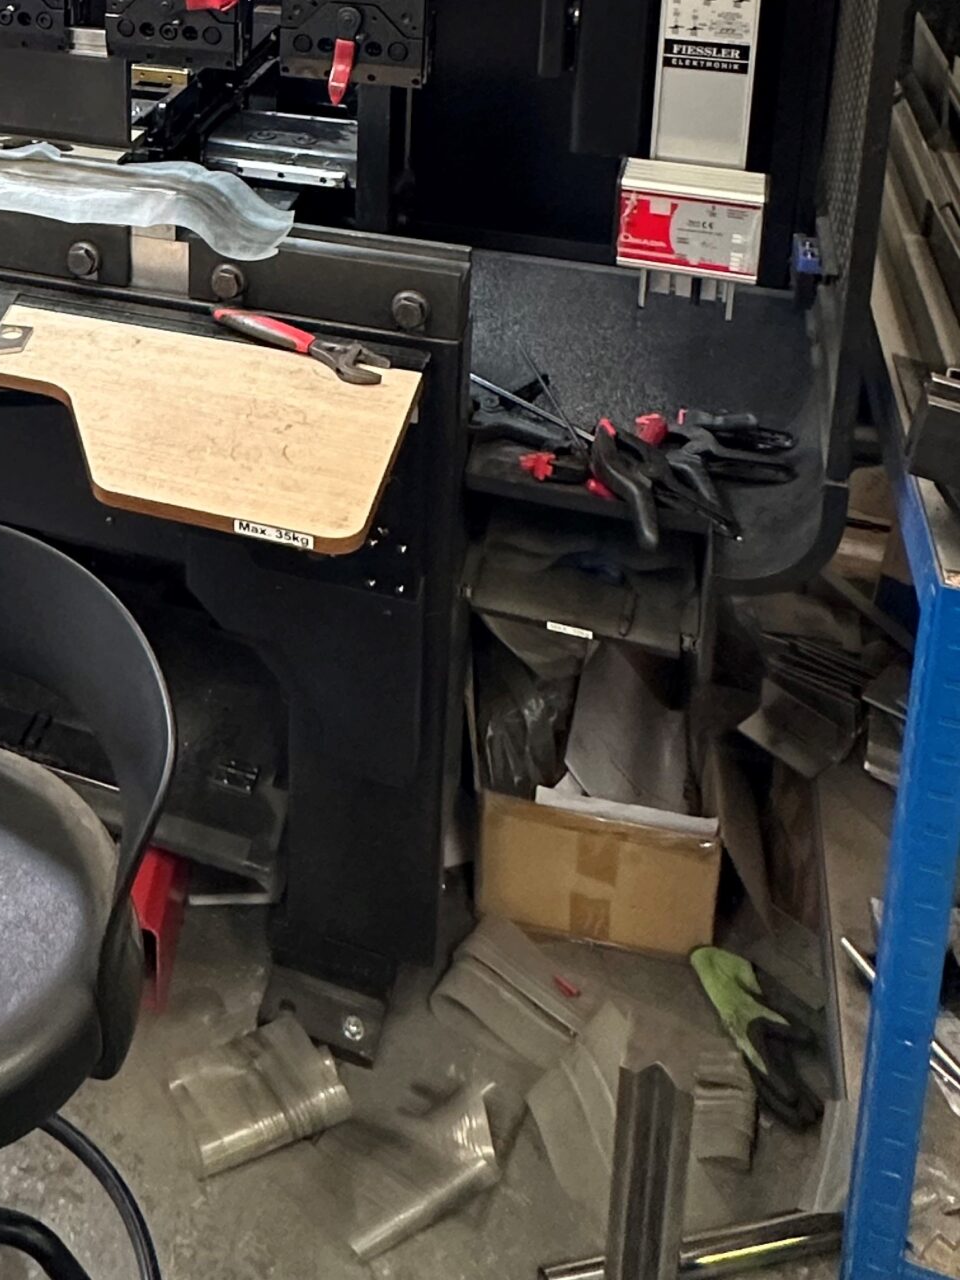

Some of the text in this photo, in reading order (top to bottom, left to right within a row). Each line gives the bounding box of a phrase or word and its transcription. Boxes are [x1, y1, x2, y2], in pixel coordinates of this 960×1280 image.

[672, 44, 740, 59] FIESSLER
[672, 58, 740, 70] ELEKTRONIK
[276, 530, 310, 546] 35kg
